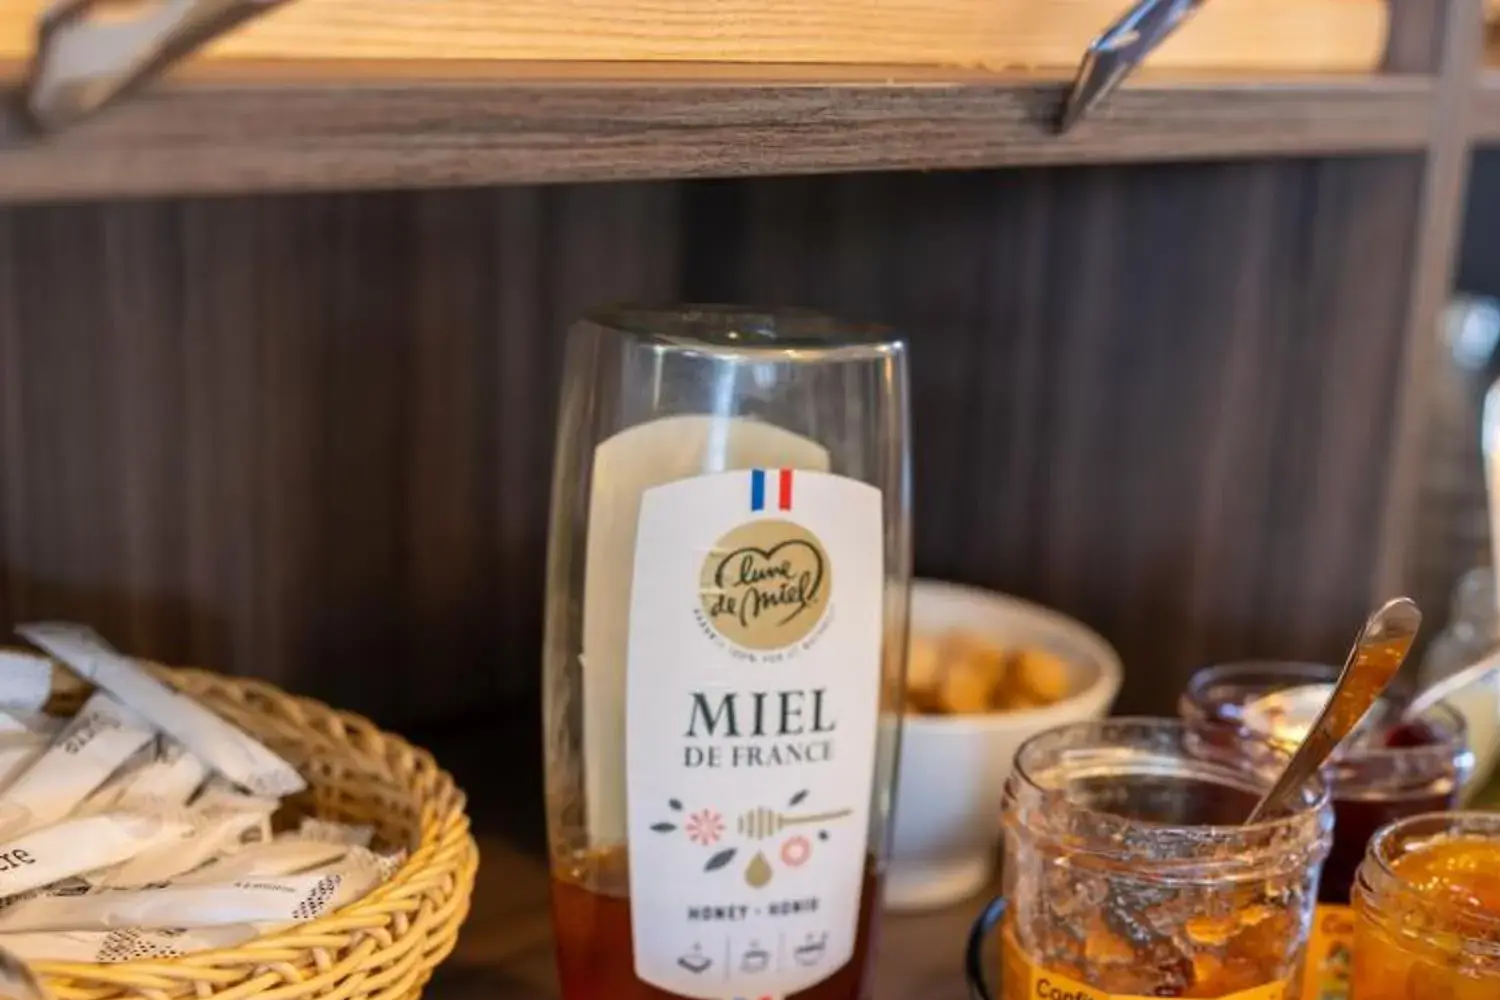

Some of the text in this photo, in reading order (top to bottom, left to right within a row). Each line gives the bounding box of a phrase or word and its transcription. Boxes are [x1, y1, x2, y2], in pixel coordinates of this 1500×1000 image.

[683, 689, 837, 738] MIEL
[683, 740, 834, 768] DE FRANCE
[687, 903, 748, 921] HONEY
